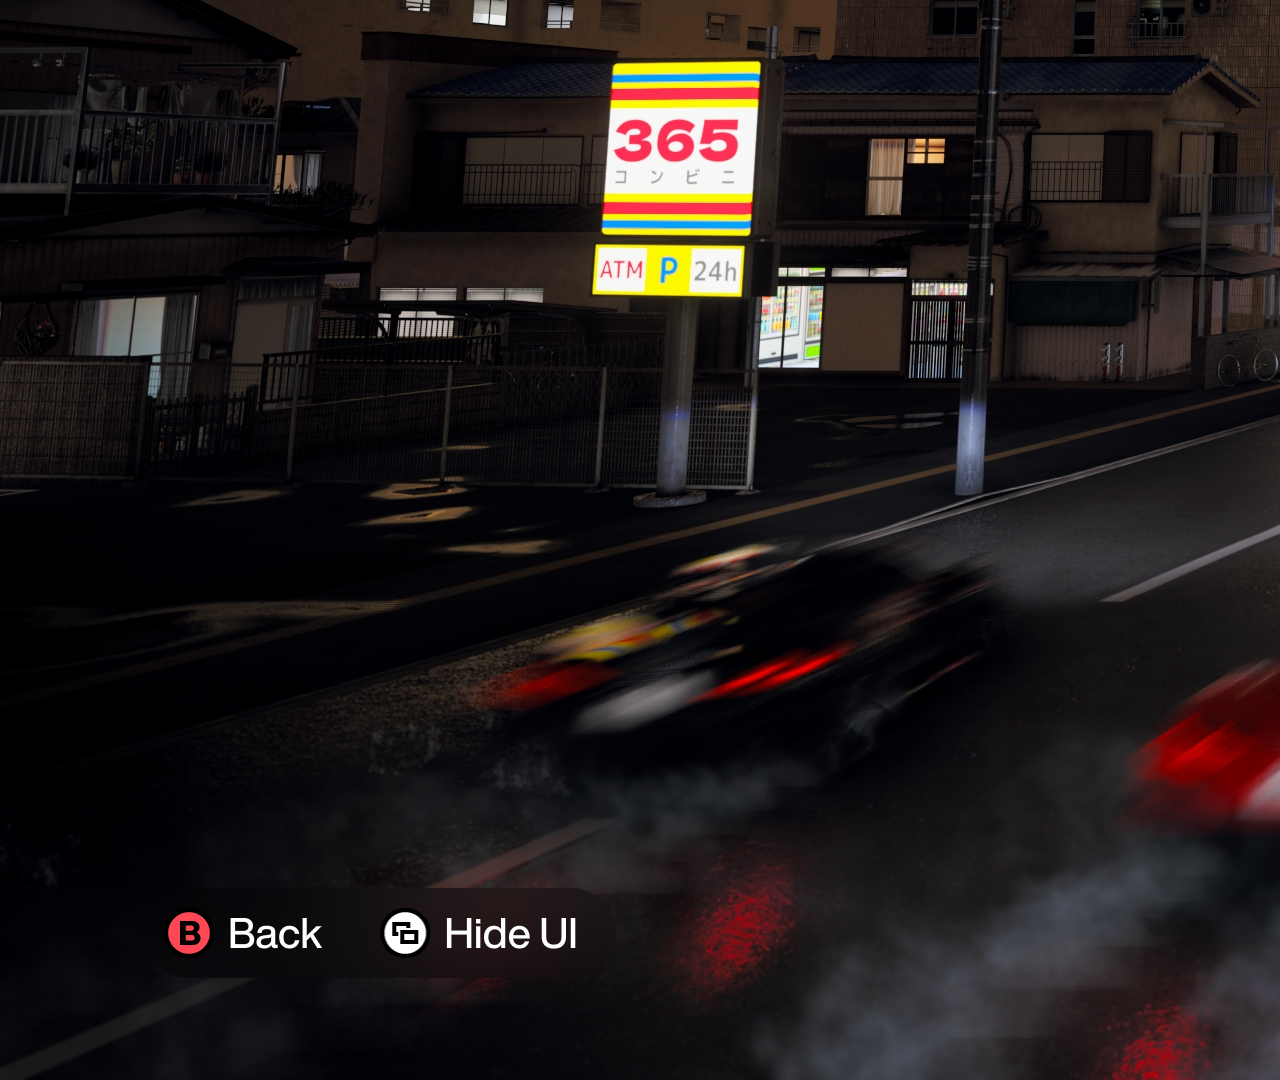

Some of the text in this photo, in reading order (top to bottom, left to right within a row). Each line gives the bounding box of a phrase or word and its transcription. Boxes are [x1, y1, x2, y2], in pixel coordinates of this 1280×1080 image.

[614, 119, 739, 163] 365
[615, 169, 735, 185] コンビニ
[600, 257, 737, 284] ATM P 24h
